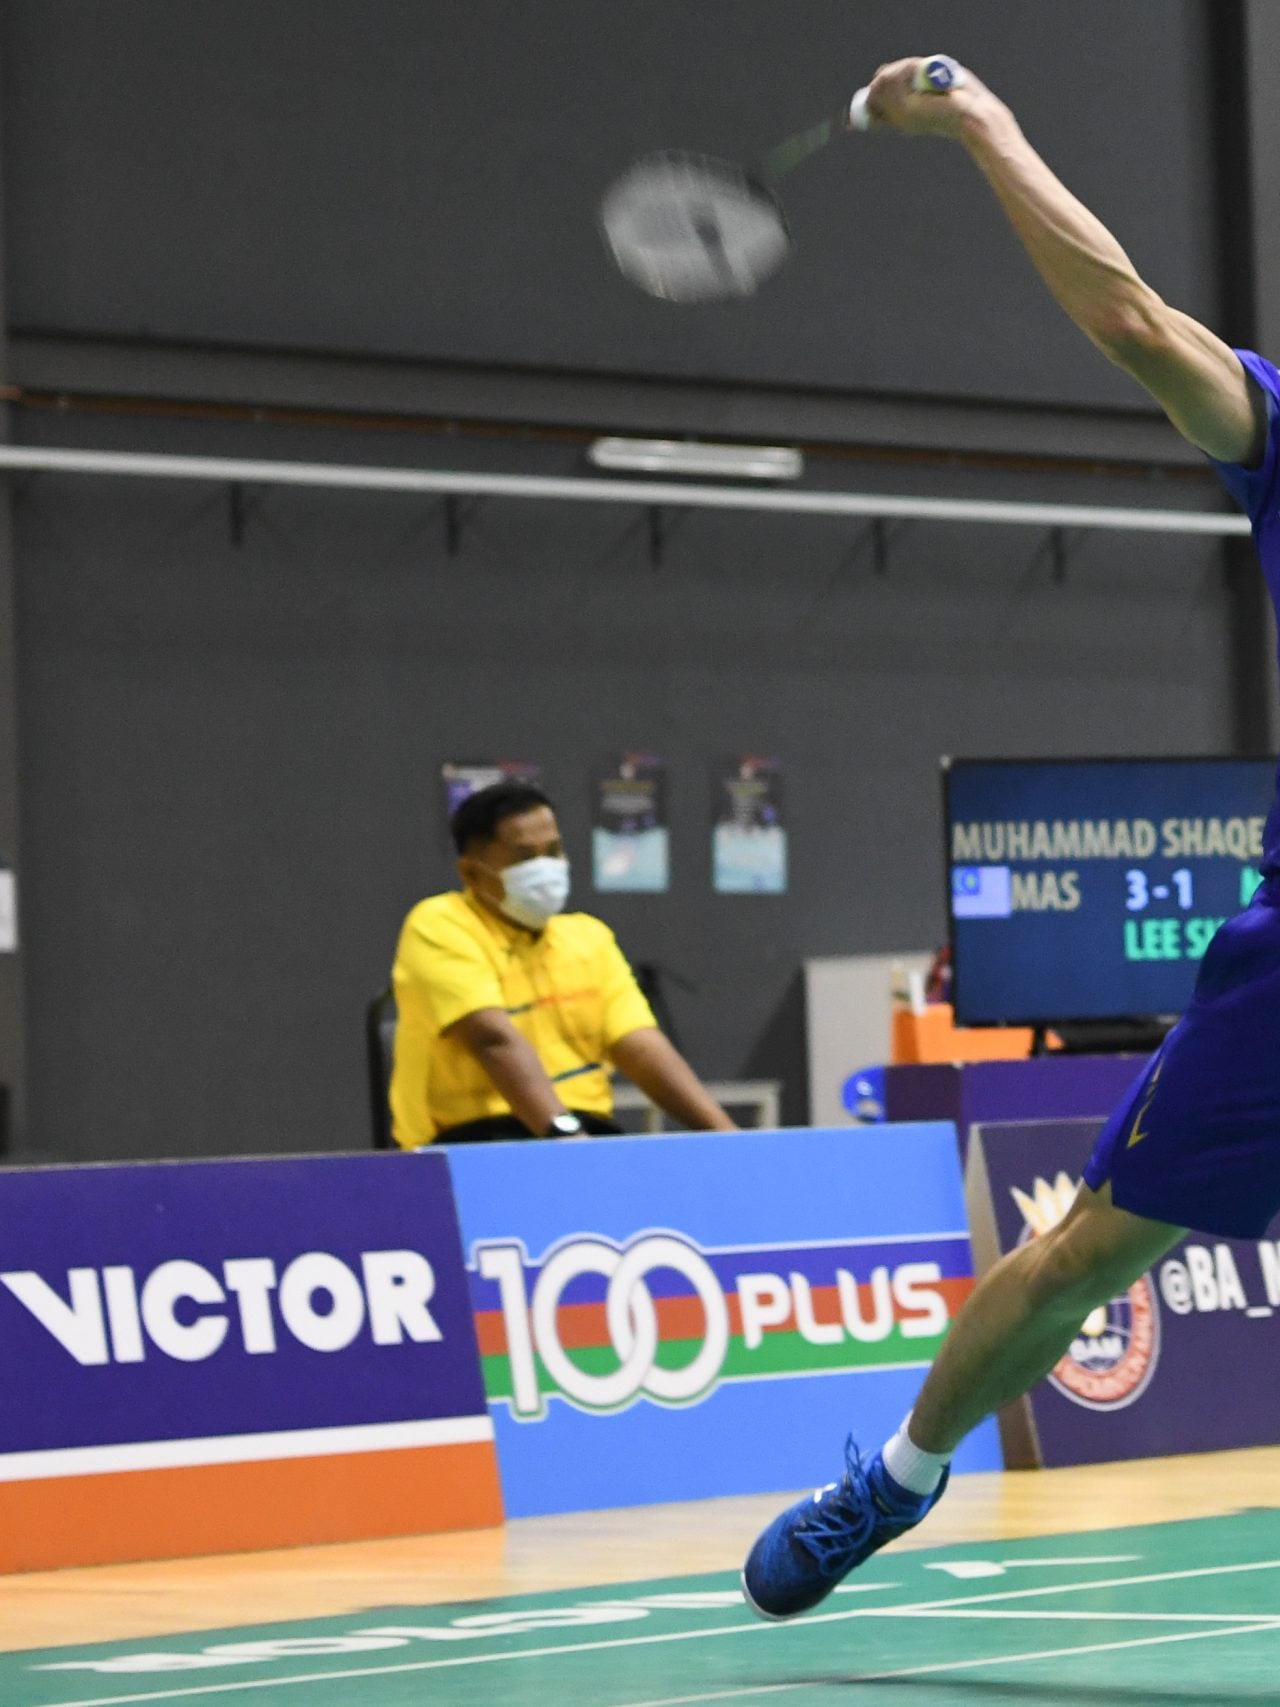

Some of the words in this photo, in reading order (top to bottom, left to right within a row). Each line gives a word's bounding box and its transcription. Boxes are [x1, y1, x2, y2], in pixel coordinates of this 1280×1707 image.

[952, 819, 1156, 860] MUHAMMAD
[1011, 871, 1081, 911] MAS
[1125, 918, 1180, 960] LEE
[1, 1249, 443, 1365] VICTOR
[476, 1234, 730, 1415] 100
[735, 1261, 949, 1350] PLUS
